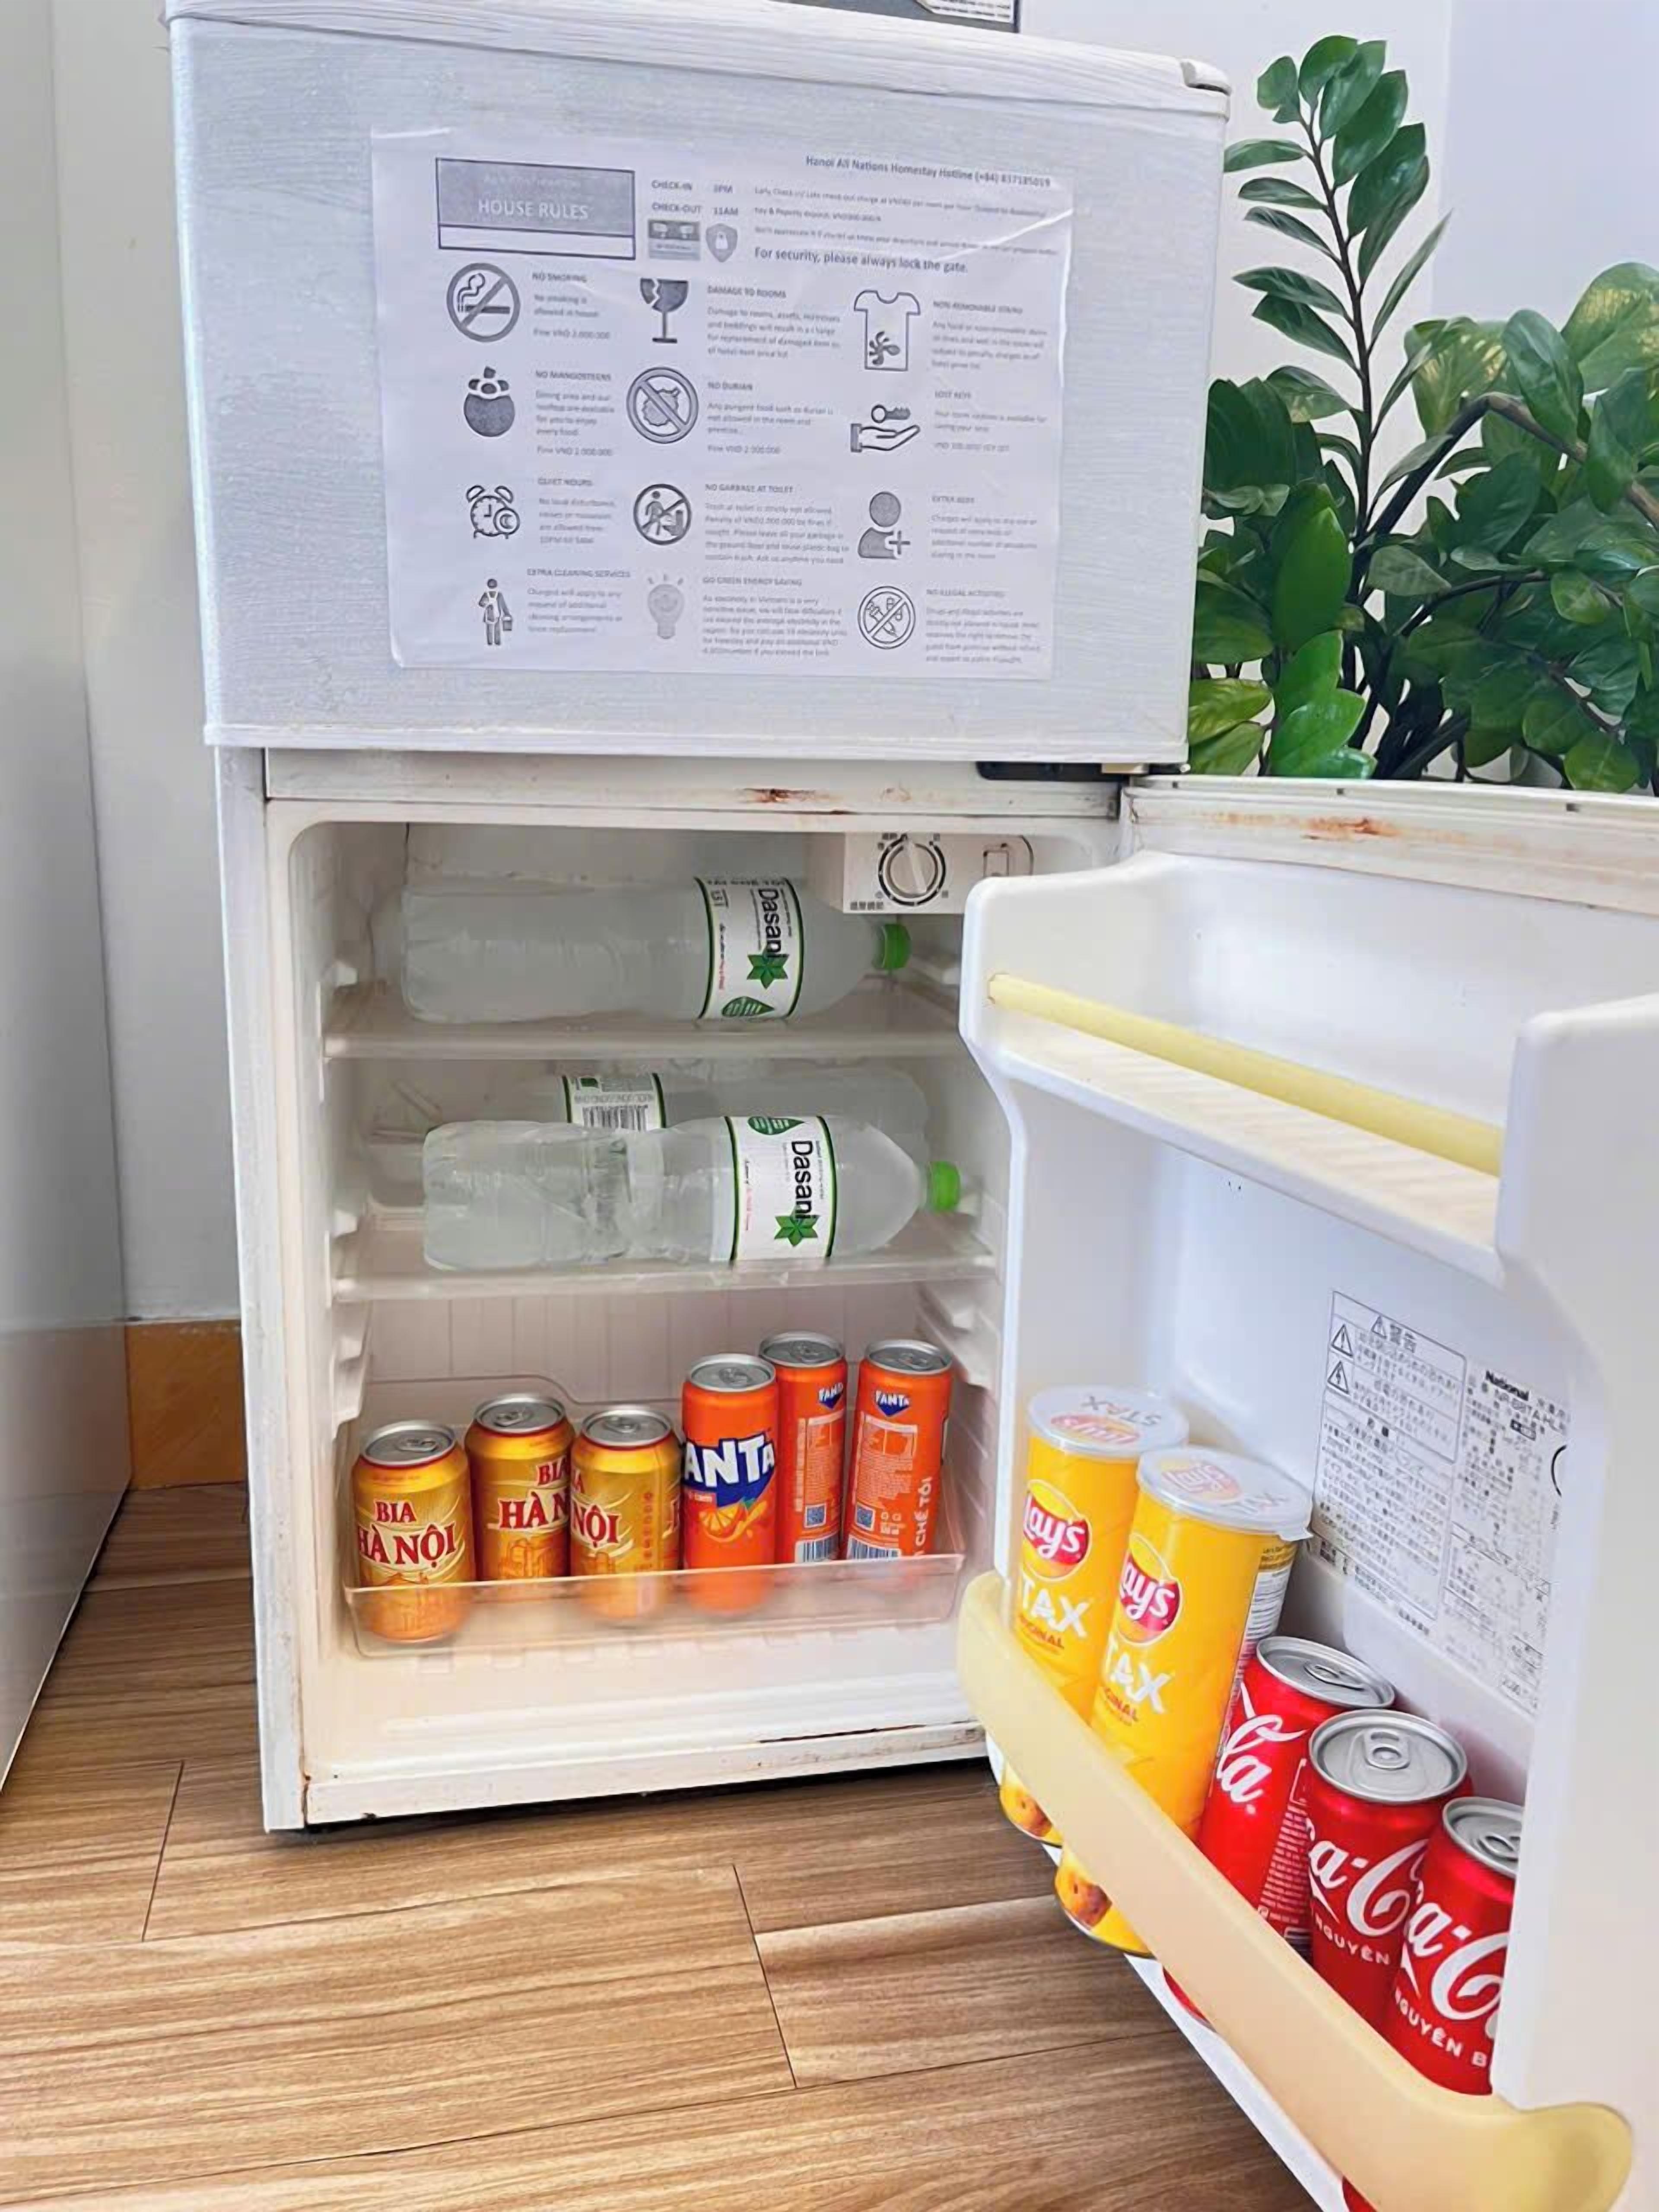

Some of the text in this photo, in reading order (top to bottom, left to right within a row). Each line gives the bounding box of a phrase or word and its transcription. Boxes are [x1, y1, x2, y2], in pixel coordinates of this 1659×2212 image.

[805, 156, 835, 167] Hanoi
[836, 158, 850, 169] All
[852, 160, 888, 172] Nations
[891, 162, 937, 178] Homestay
[939, 167, 973, 180] Hotline
[651, 179, 693, 191] CHECK-IN
[478, 199, 589, 220] HOUSE RULES
[652, 202, 702, 214] CHECK-OUT
[754, 246, 968, 273] For security, please always lock the gate.
[533, 272, 587, 283] NO SMOKING
[707, 286, 786, 299] DAMAGE TO ROOMS
[535, 370, 548, 378] NO
[722, 382, 753, 391] DURIAN
[719, 484, 755, 492] GARBAGE
[791, 1141, 818, 1219] Dasani
[819, 1382, 843, 1402] FANT
[1485, 1370, 1530, 1402] National
[876, 1390, 910, 1407] FANTA
[684, 1434, 775, 1488] ANTA
[377, 1501, 417, 1523] BIA
[498, 1491, 549, 1529] HÀ
[358, 1523, 456, 1569] HÀ NỘI
[1119, 1562, 1176, 1621] ay's
[1022, 1569, 1091, 1638] TAX
[1106, 1632, 1176, 1715] TAX
